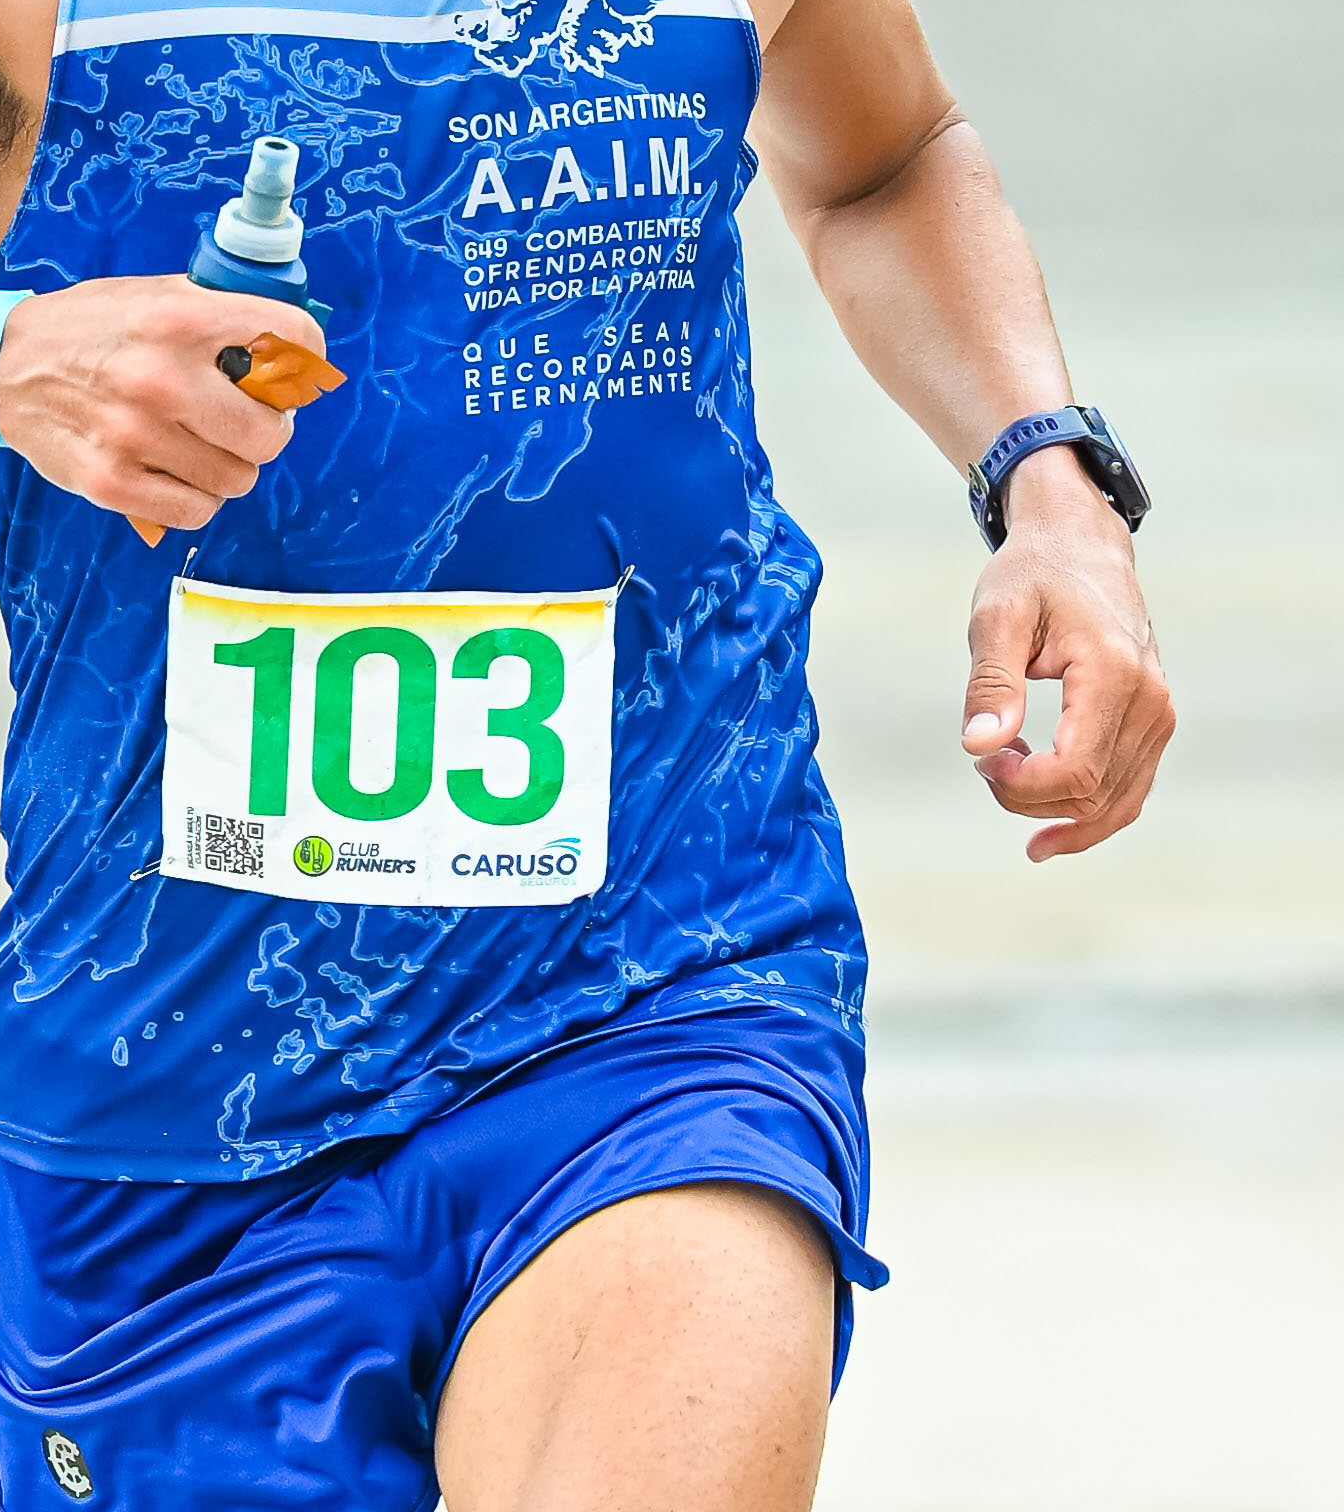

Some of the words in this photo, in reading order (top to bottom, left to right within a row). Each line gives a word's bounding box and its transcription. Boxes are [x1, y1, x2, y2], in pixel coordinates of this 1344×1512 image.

[448, 110, 518, 143] SON
[527, 92, 706, 134] ARGENTINAS
[461, 137, 702, 218] A.A.I.M.
[464, 237, 507, 261] 649
[525, 217, 701, 252] COMBATIENTES
[463, 244, 662, 286] OFRENDARON
[675, 243, 698, 264] SU
[463, 286, 522, 312] VIDA
[531, 280, 582, 303] POR
[591, 274, 622, 296] LA
[629, 269, 695, 293] PATRIA
[462, 333, 550, 363] QUE
[464, 345, 692, 389] RECORDADOS
[465, 371, 692, 415] ETERNAMENTE
[214, 626, 565, 826] 103
[336, 857, 416, 874] RUNNER'S
[338, 842, 380, 857] CLUB
[451, 853, 578, 877] CARUSO
[519, 877, 577, 887] SEGUROS
